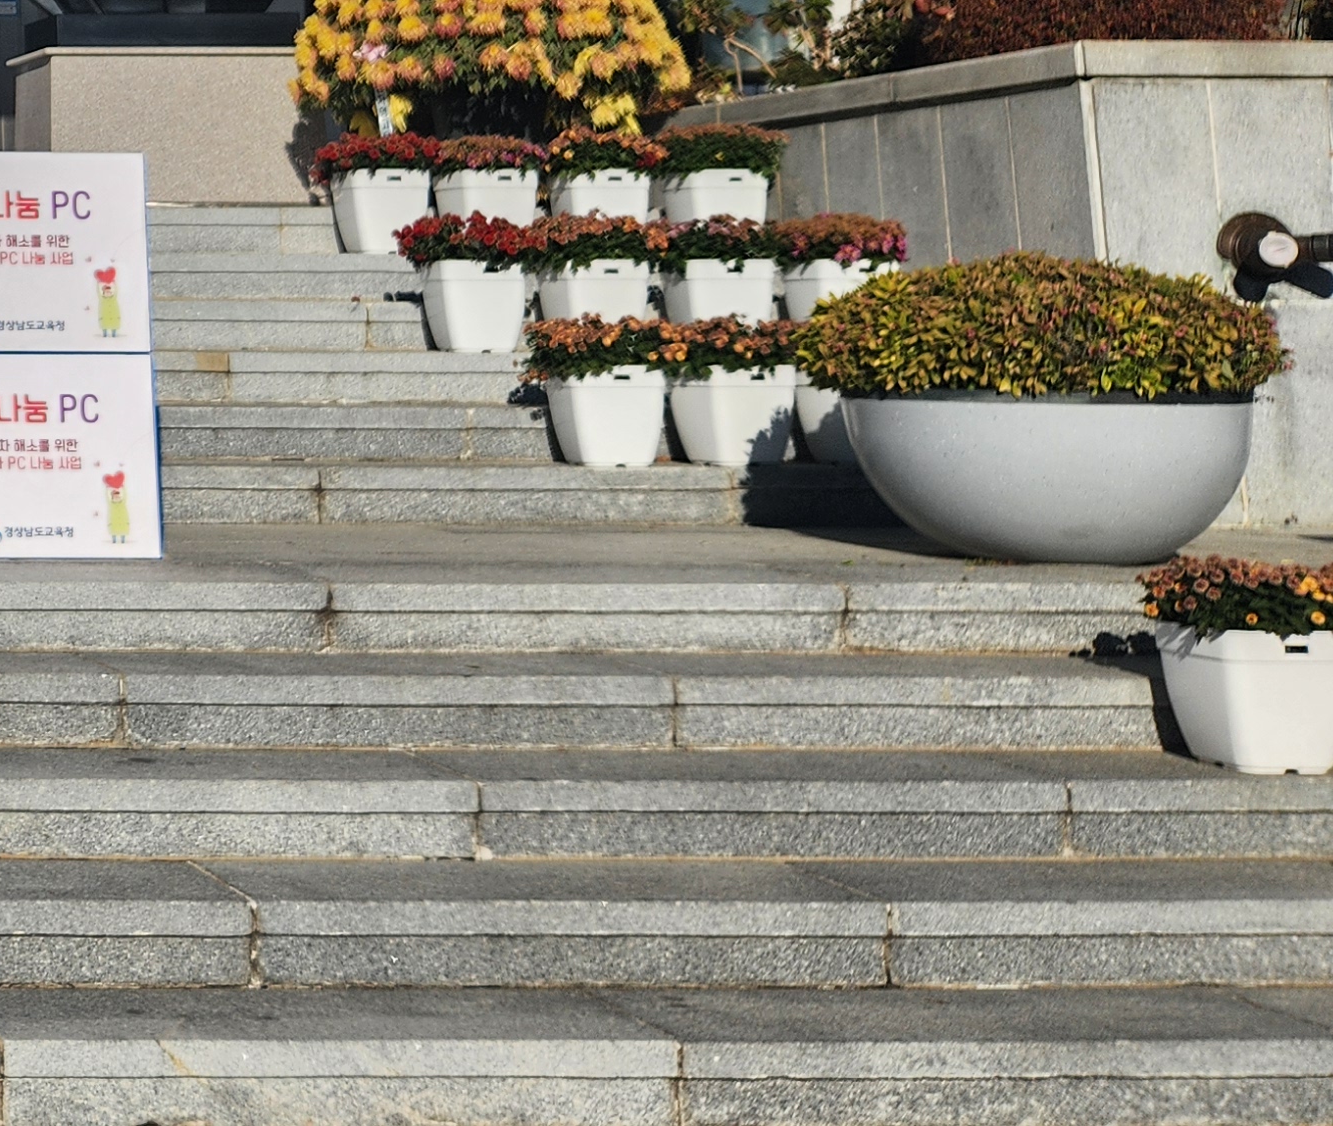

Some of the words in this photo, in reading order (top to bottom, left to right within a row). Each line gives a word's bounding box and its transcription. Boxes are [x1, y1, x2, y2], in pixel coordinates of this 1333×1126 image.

[52, 191, 90, 220] PC
[60, 394, 99, 423] PC
[5, 527, 74, 538] 경상남도교육청
